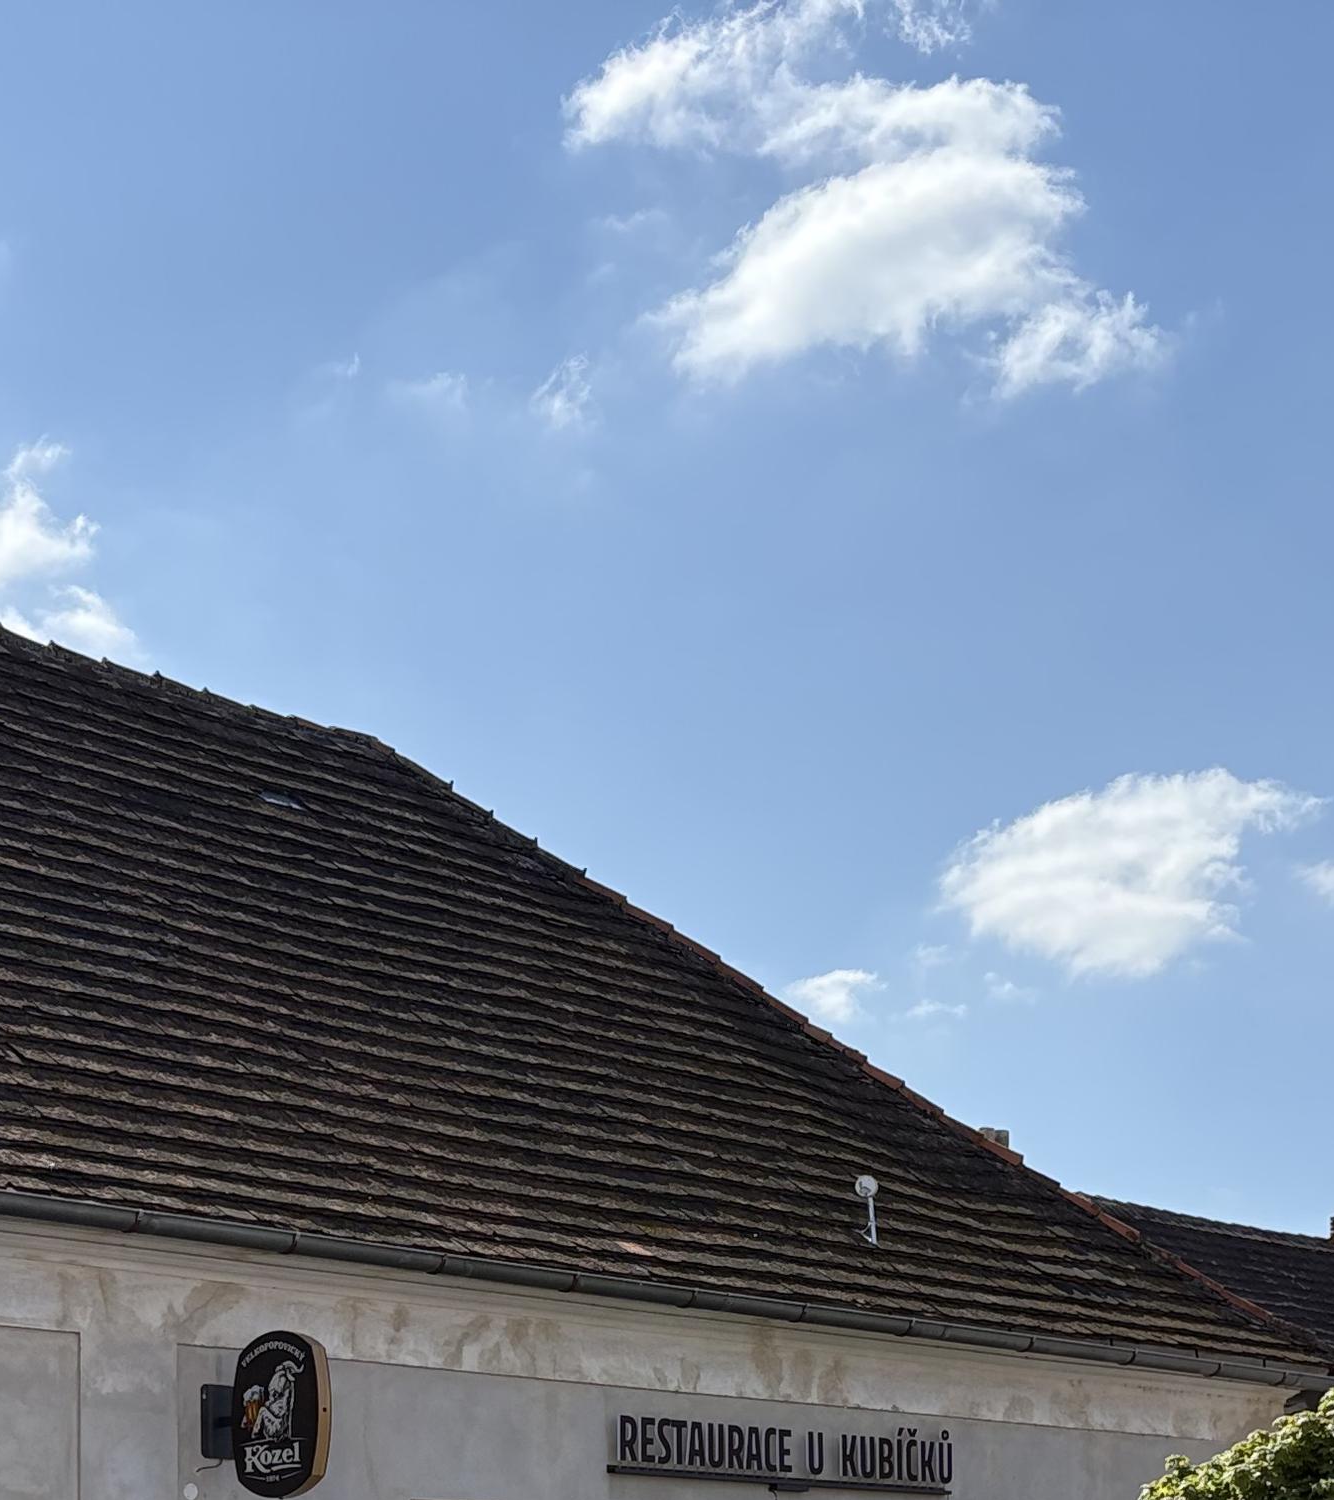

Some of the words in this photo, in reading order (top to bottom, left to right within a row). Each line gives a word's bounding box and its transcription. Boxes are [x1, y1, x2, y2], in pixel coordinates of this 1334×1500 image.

[244, 1441, 301, 1474] Kozel
[619, 1415, 792, 1473] RESTAURACE
[808, 1431, 825, 1475] U
[840, 1427, 953, 1484] KUBÍČKŮ
